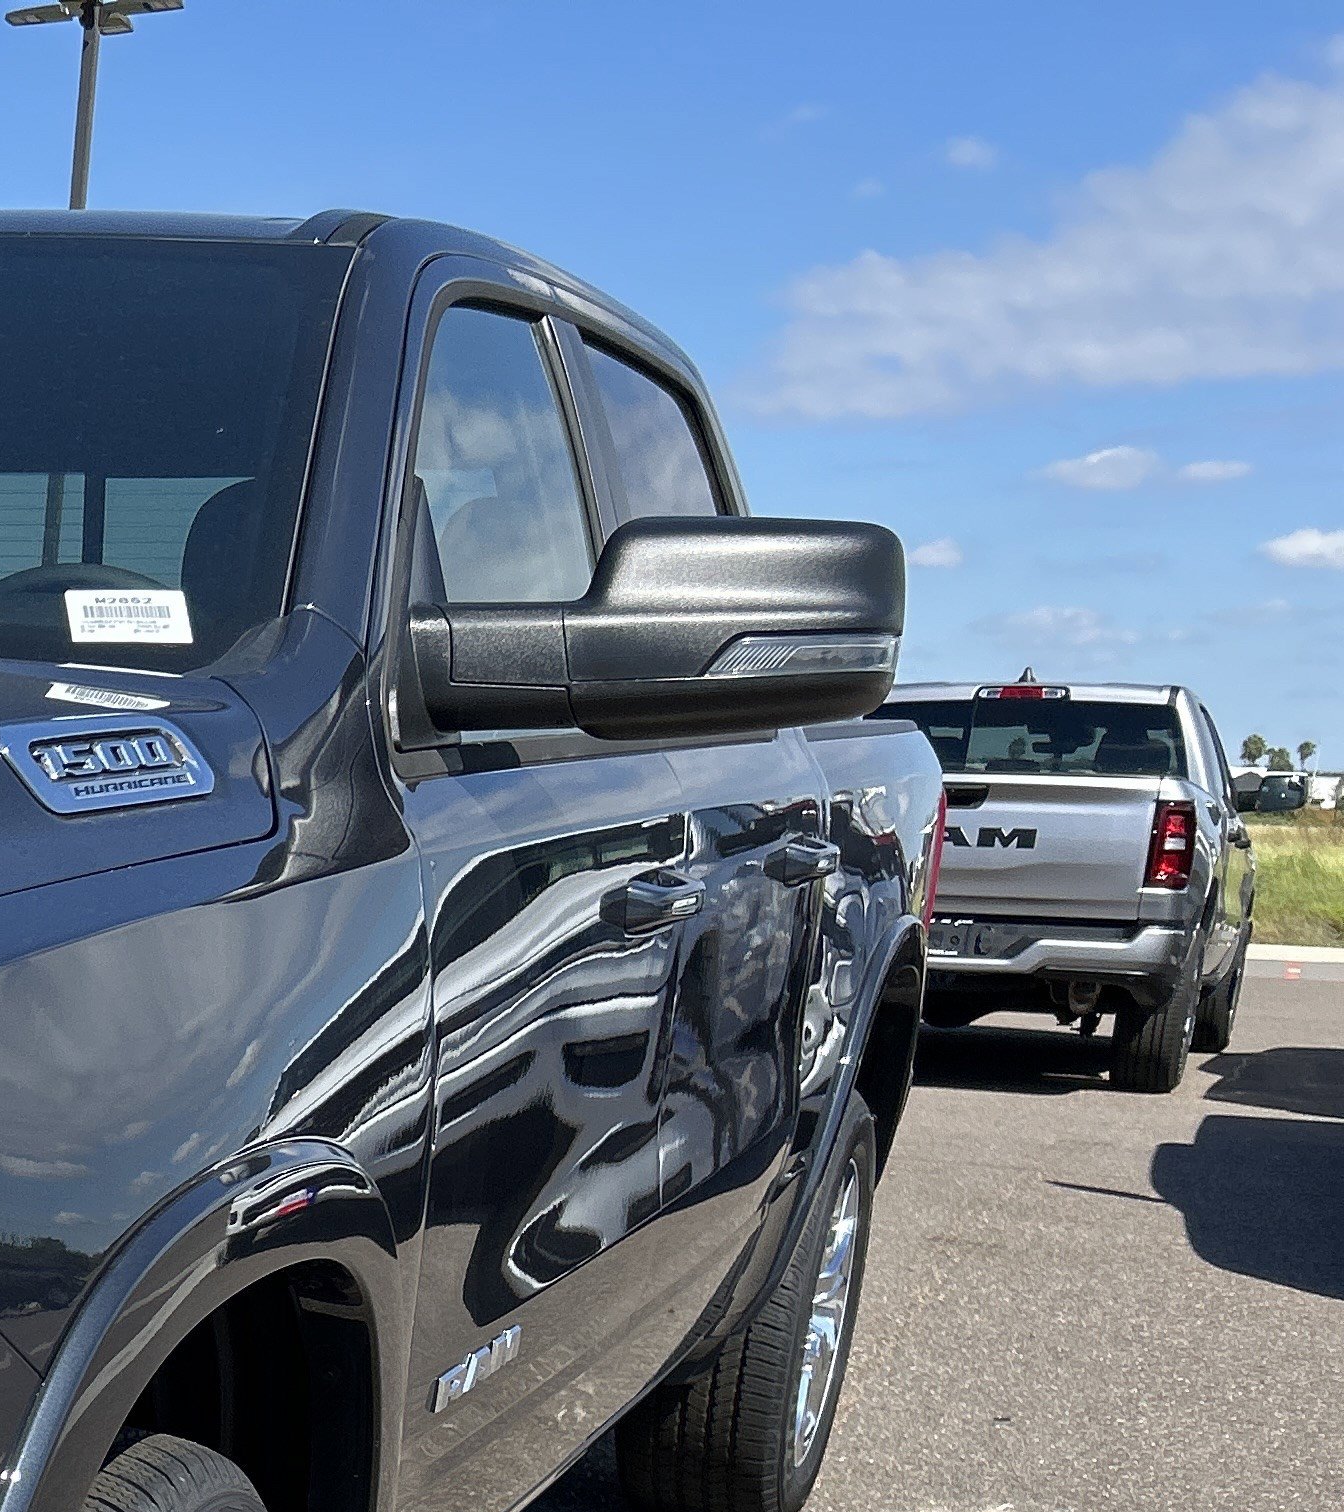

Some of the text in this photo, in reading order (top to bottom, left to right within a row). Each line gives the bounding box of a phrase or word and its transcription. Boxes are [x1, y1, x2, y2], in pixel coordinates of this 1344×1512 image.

[33, 736, 176, 781] 1500
[74, 774, 191, 797] HURRICANE
[944, 826, 1038, 850] AM
